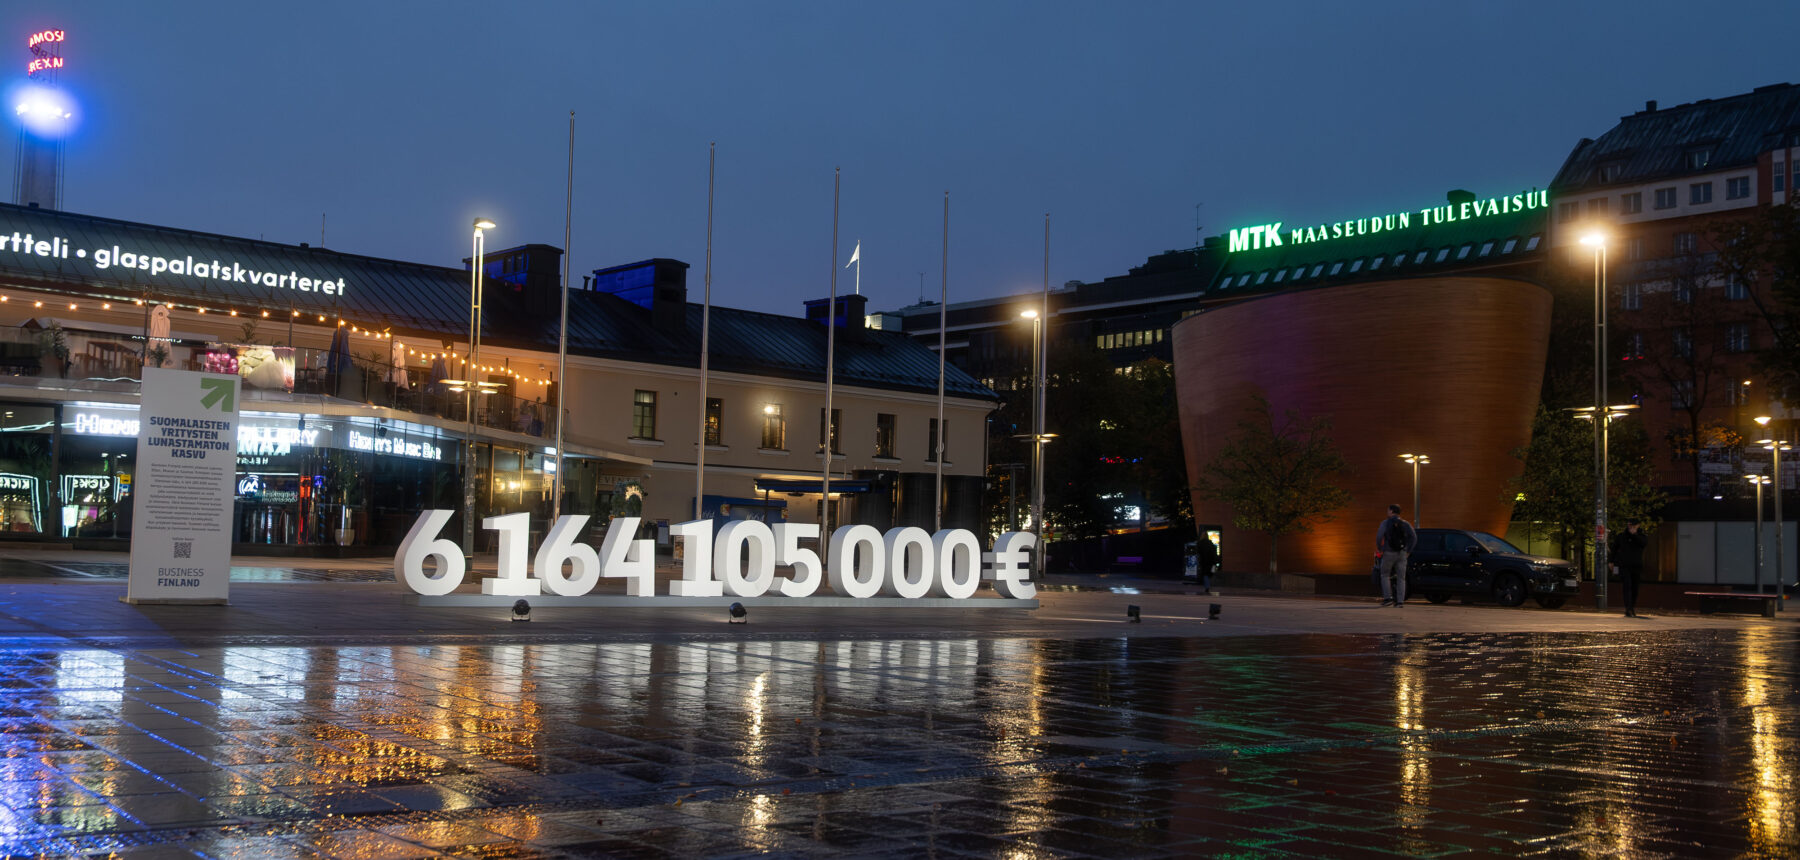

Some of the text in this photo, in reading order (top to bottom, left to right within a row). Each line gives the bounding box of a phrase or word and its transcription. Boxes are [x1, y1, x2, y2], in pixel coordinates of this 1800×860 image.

[1229, 222, 1283, 252] MTK
[1291, 212, 1410, 245] MAASEUDUN
[94, 245, 346, 296] glaspalatskvarteret
[150, 416, 230, 431] SUOMALAISTEN
[161, 427, 218, 440] YRITYSTEN
[148, 437, 230, 451] LUNASTAMATON
[171, 449, 206, 459] KASVU
[395, 509, 466, 596] 6
[482, 512, 655, 597] 164
[669, 519, 822, 597] 105
[158, 567, 204, 577] BUSINESS
[157, 578, 200, 587] FINLAND
